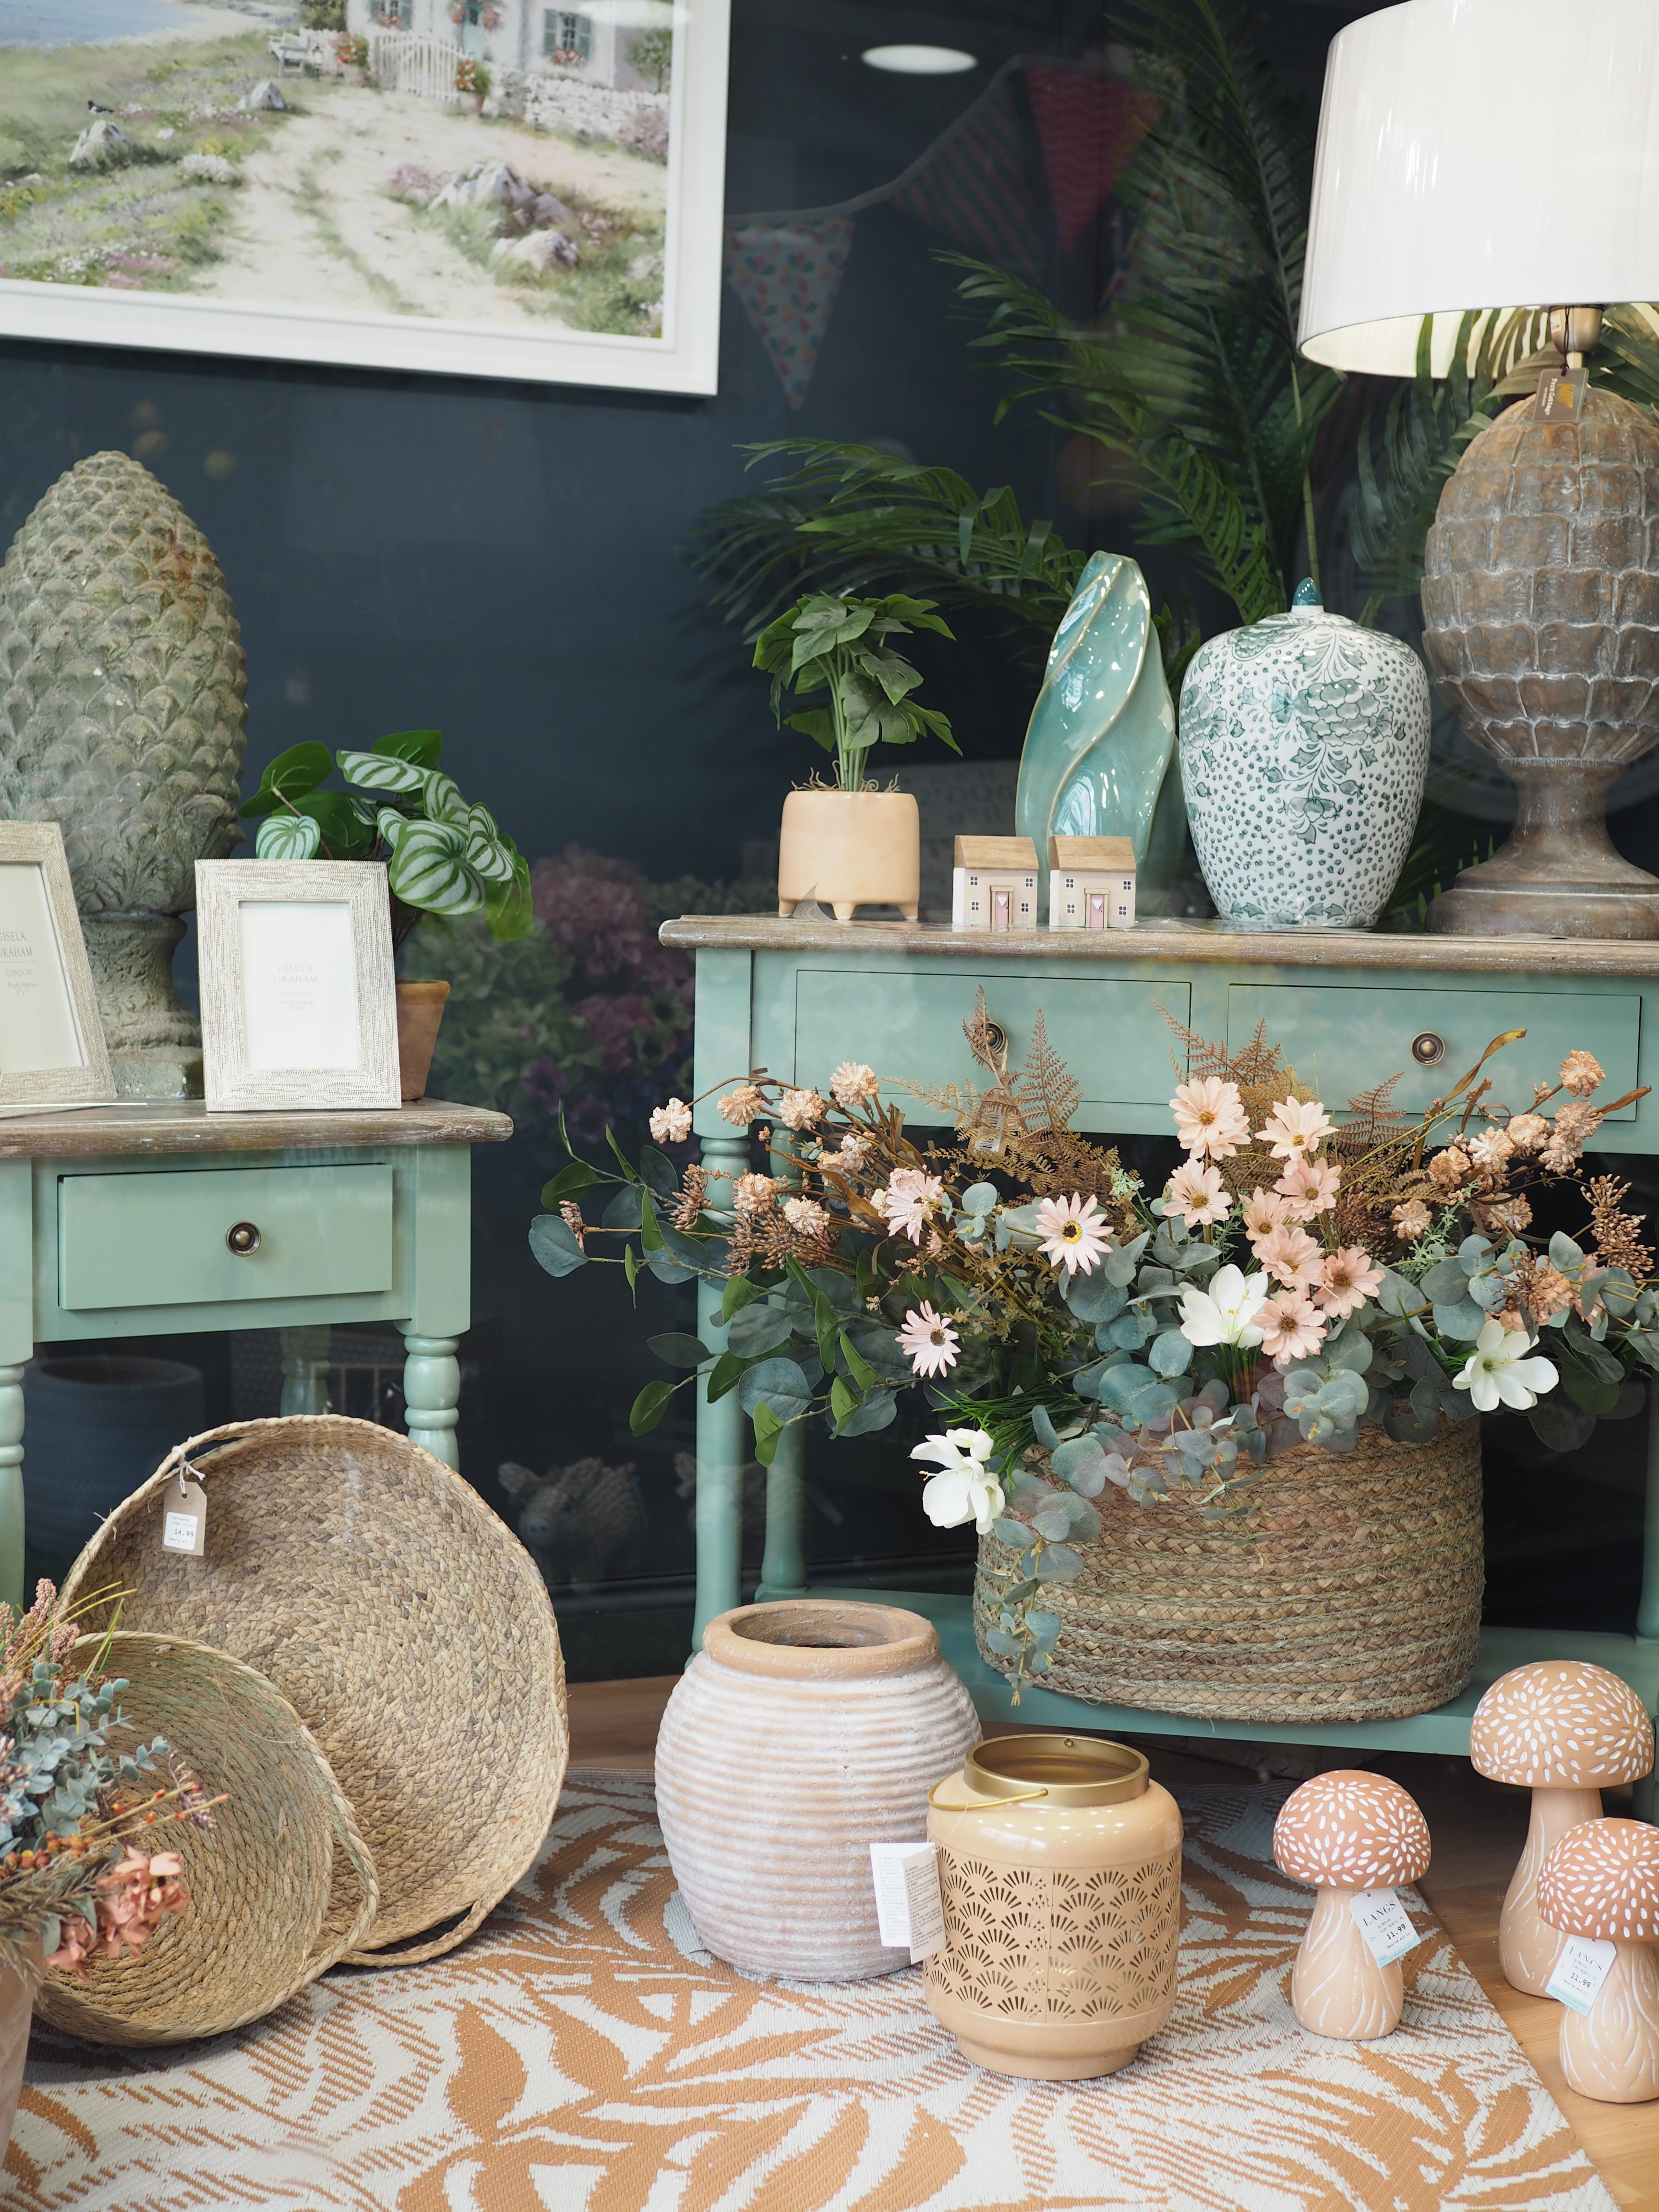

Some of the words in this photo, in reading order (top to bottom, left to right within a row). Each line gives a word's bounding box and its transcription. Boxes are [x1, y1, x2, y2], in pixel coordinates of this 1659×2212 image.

[174, 1529, 194, 1537] 14.99
[1363, 1900, 1396, 1926] LANGS
[1387, 1923, 1406, 1939] 11.99
[1571, 1972, 1591, 1988] 11.99
